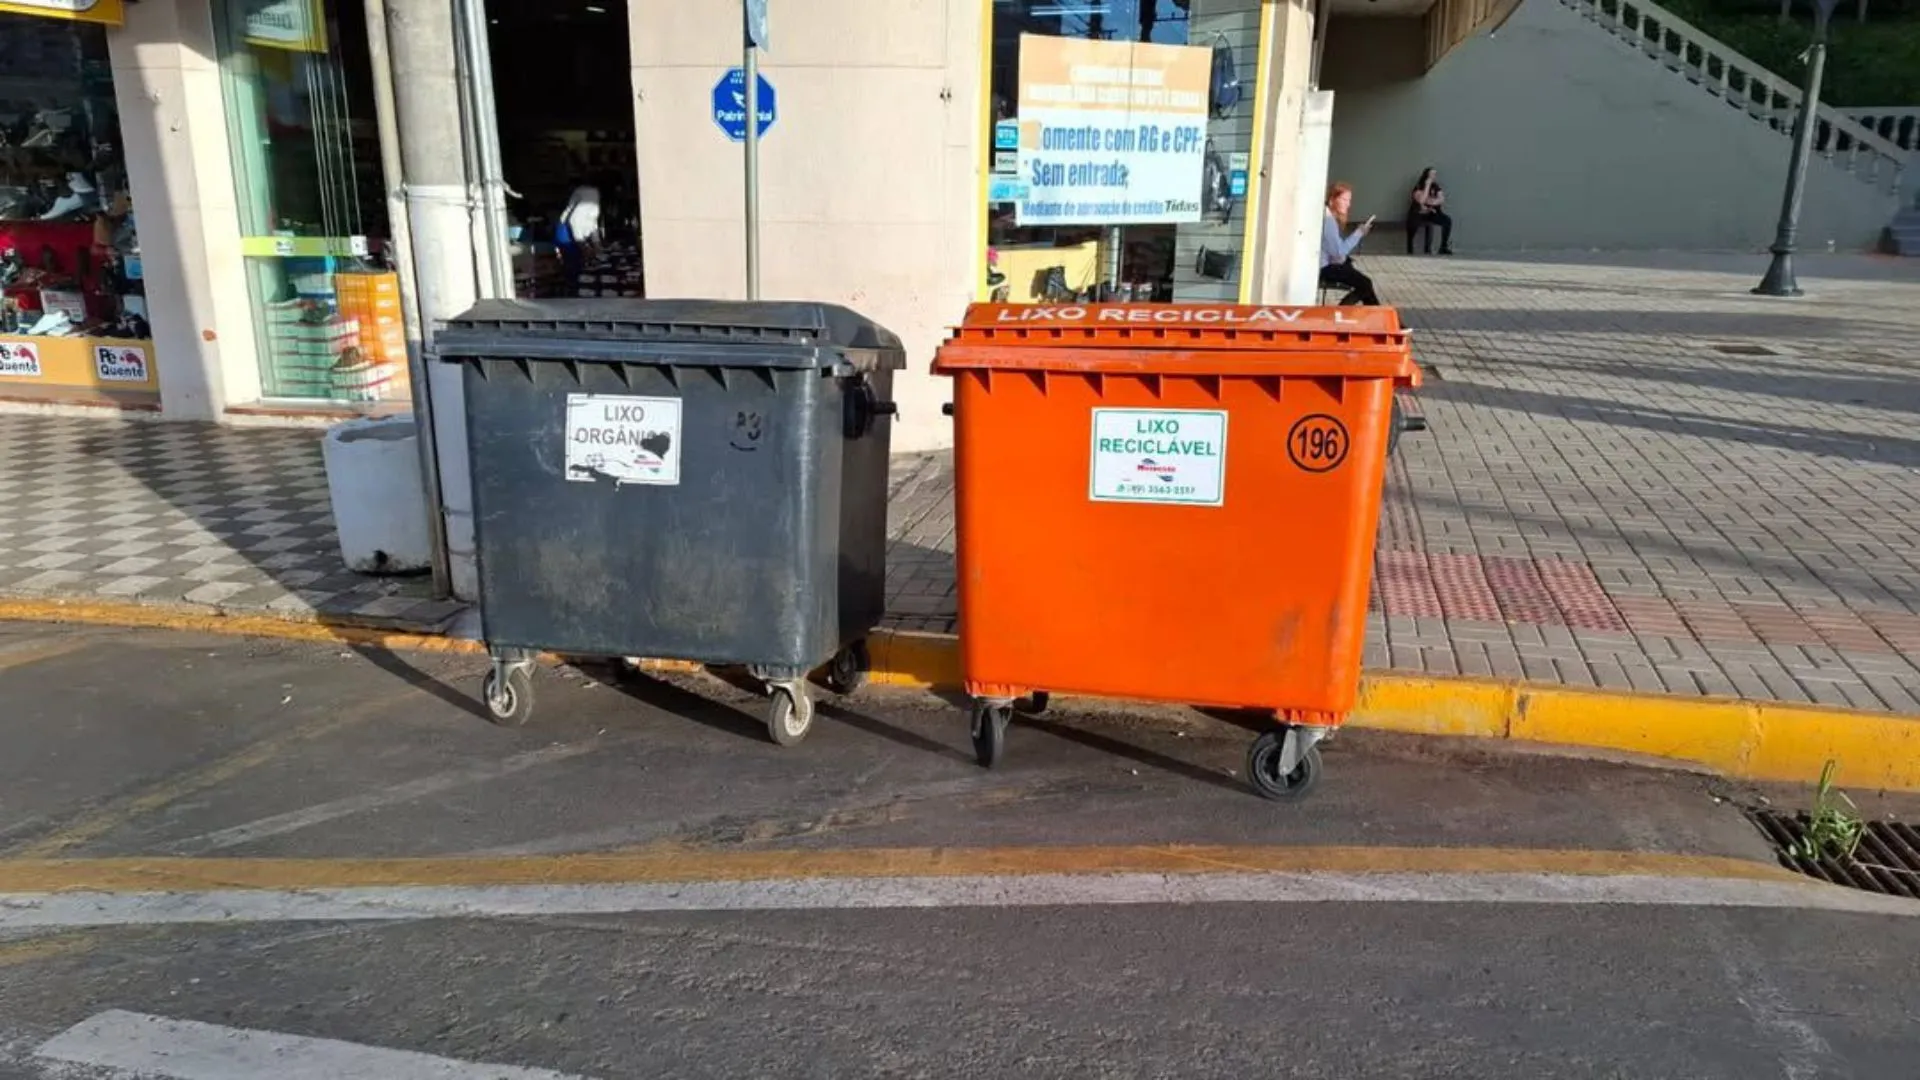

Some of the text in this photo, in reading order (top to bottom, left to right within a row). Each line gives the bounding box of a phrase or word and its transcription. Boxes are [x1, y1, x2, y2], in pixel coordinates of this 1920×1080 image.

[1042, 125, 1101, 151] omente
[1104, 128, 1135, 152] com
[1138, 124, 1158, 152] RG
[1161, 130, 1170, 153] e
[1032, 158, 1064, 187] Sem
[998, 307, 1087, 321] LIXO
[100, 364, 145, 377] Quente
[603, 405, 645, 423] LIXO
[1137, 419, 1180, 434] LIXO
[1099, 436, 1216, 456] RECICLÁVEL
[1297, 427, 1339, 460] 196
